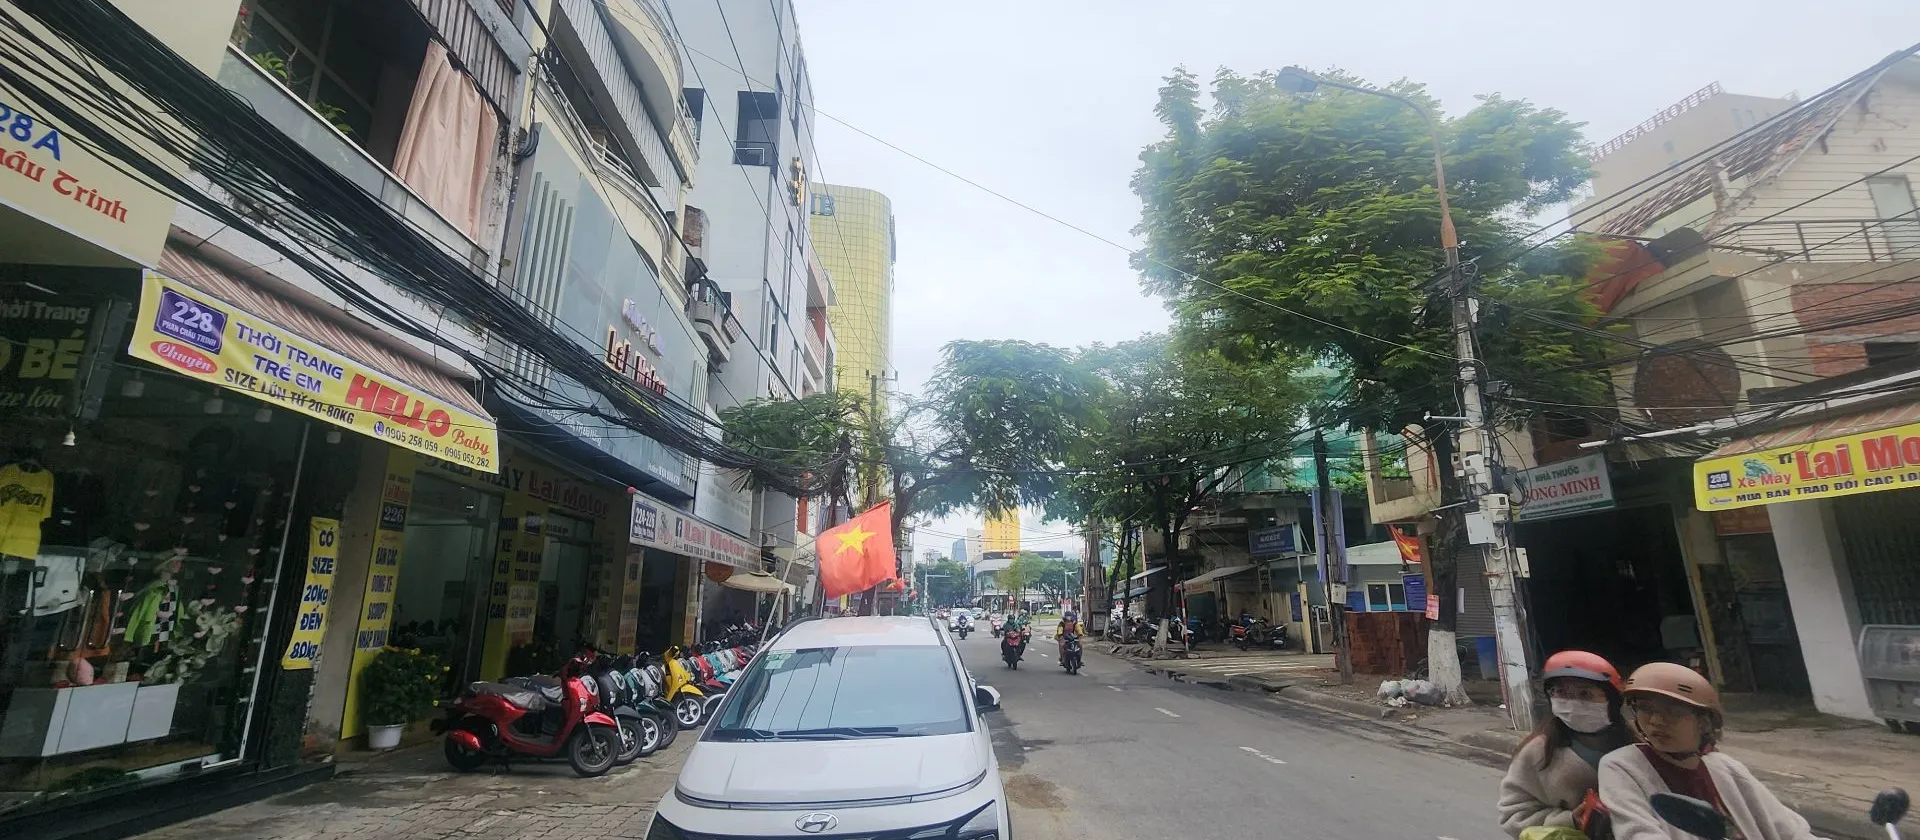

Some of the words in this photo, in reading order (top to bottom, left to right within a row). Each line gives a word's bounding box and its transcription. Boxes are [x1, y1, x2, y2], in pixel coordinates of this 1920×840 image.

[52, 169, 128, 224] Trinh
[162, 319, 180, 334] PHAN
[170, 301, 214, 333] 228
[236, 322, 282, 354] THỜI
[286, 343, 344, 381] TRANG
[254, 354, 291, 382] TRẺ
[295, 372, 322, 394] EM
[224, 367, 258, 391] SIZE
[308, 398, 355, 425] 20-80KG
[345, 373, 450, 438] HELLO
[385, 427, 407, 443] 0905
[407, 437, 423, 448] 258
[424, 441, 438, 453] 059
[444, 448, 462, 460] 0905
[462, 454, 475, 465] 052
[476, 457, 490, 469] 282
[451, 428, 490, 456] Baby
[1795, 444, 1853, 481] Lai
[1559, 475, 1600, 497] MINH
[1736, 493, 1761, 502] MUA
[1796, 484, 1829, 495] TRAO
[1737, 476, 1756, 488] Xe
[383, 506, 405, 523] 226
[318, 527, 335, 548] CÓ
[310, 556, 334, 575] SIZE
[303, 584, 329, 606] 20kg
[300, 604, 323, 631] ĐẾN
[289, 641, 319, 661] 80kg
